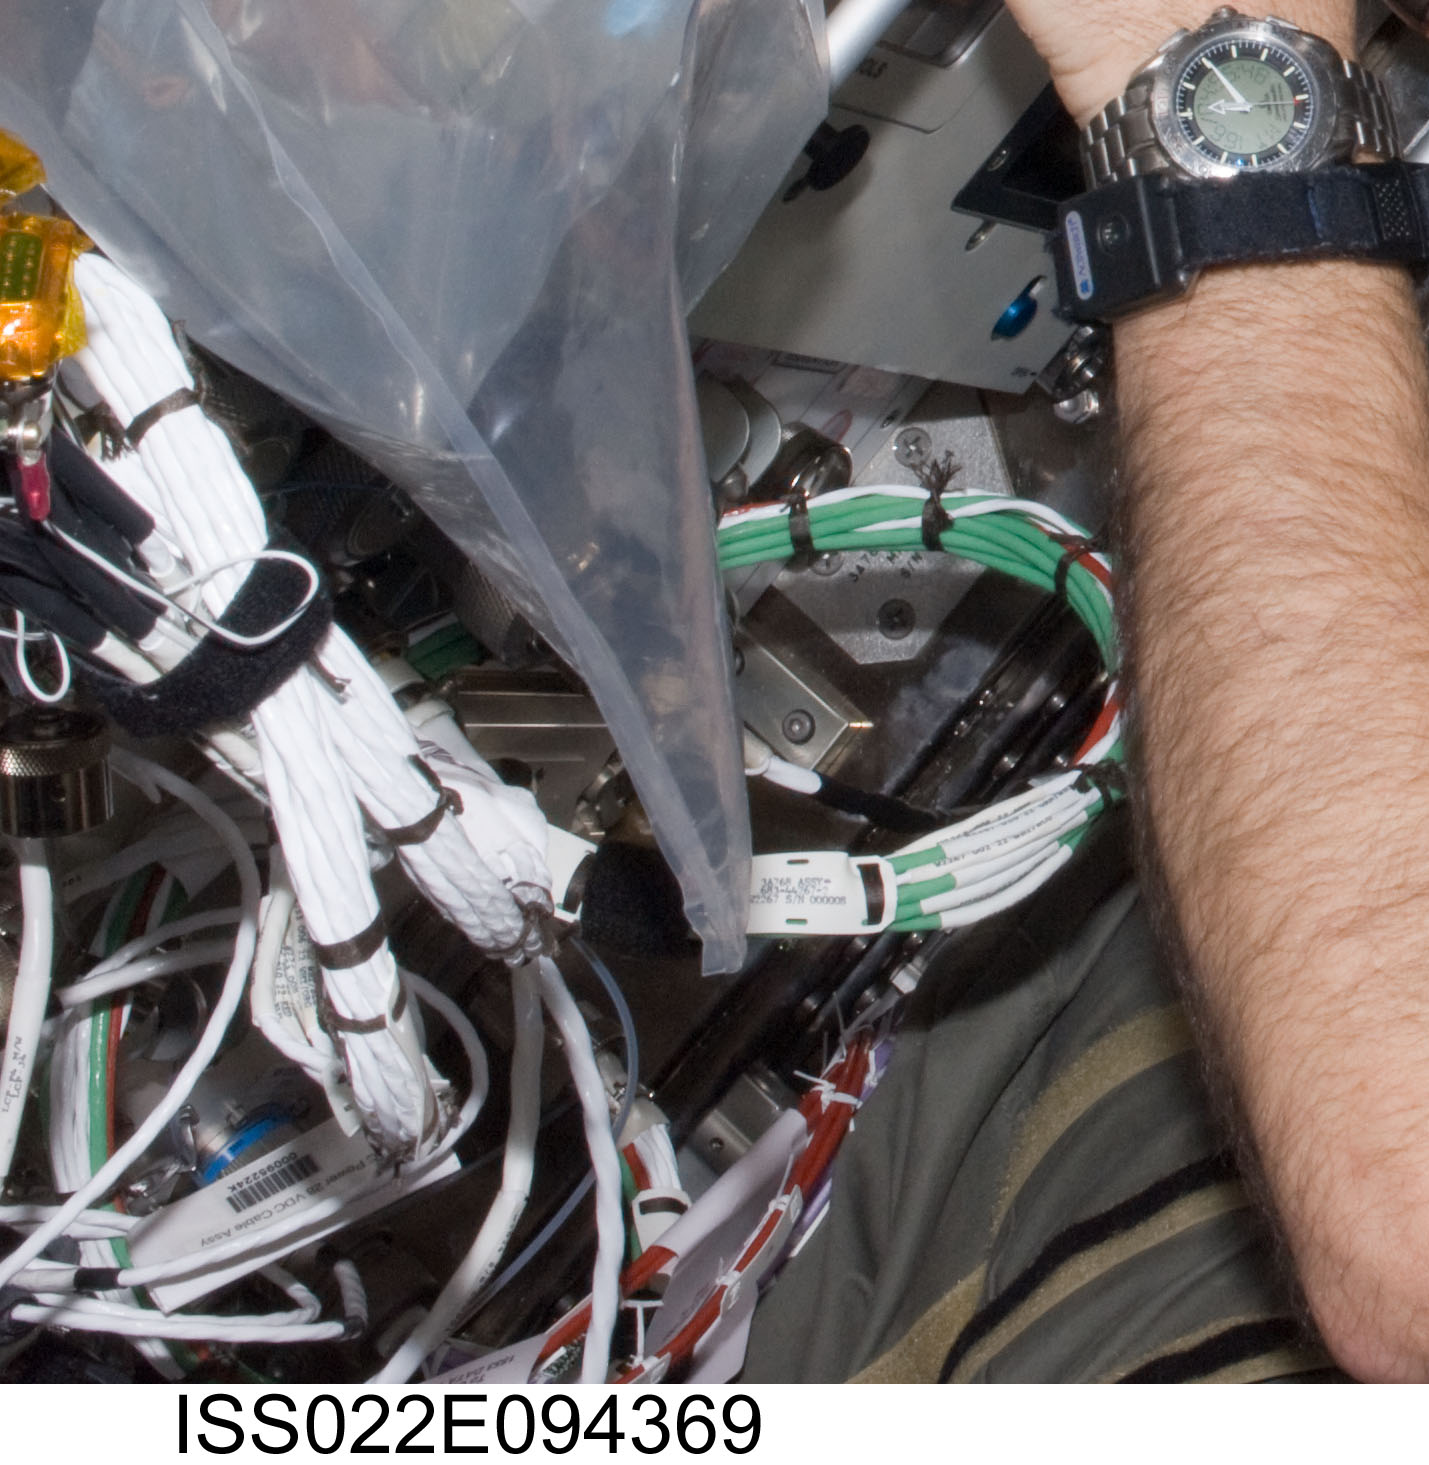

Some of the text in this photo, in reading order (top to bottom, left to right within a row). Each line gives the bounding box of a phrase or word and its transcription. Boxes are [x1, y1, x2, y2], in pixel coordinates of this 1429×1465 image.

[225, 1150, 299, 1194] 00095224K
[323, 1158, 366, 1186] Power
[305, 1181, 323, 1196] 28
[272, 1191, 304, 1213] VDC
[232, 1206, 273, 1233] Cable
[198, 1225, 233, 1249] Assy
